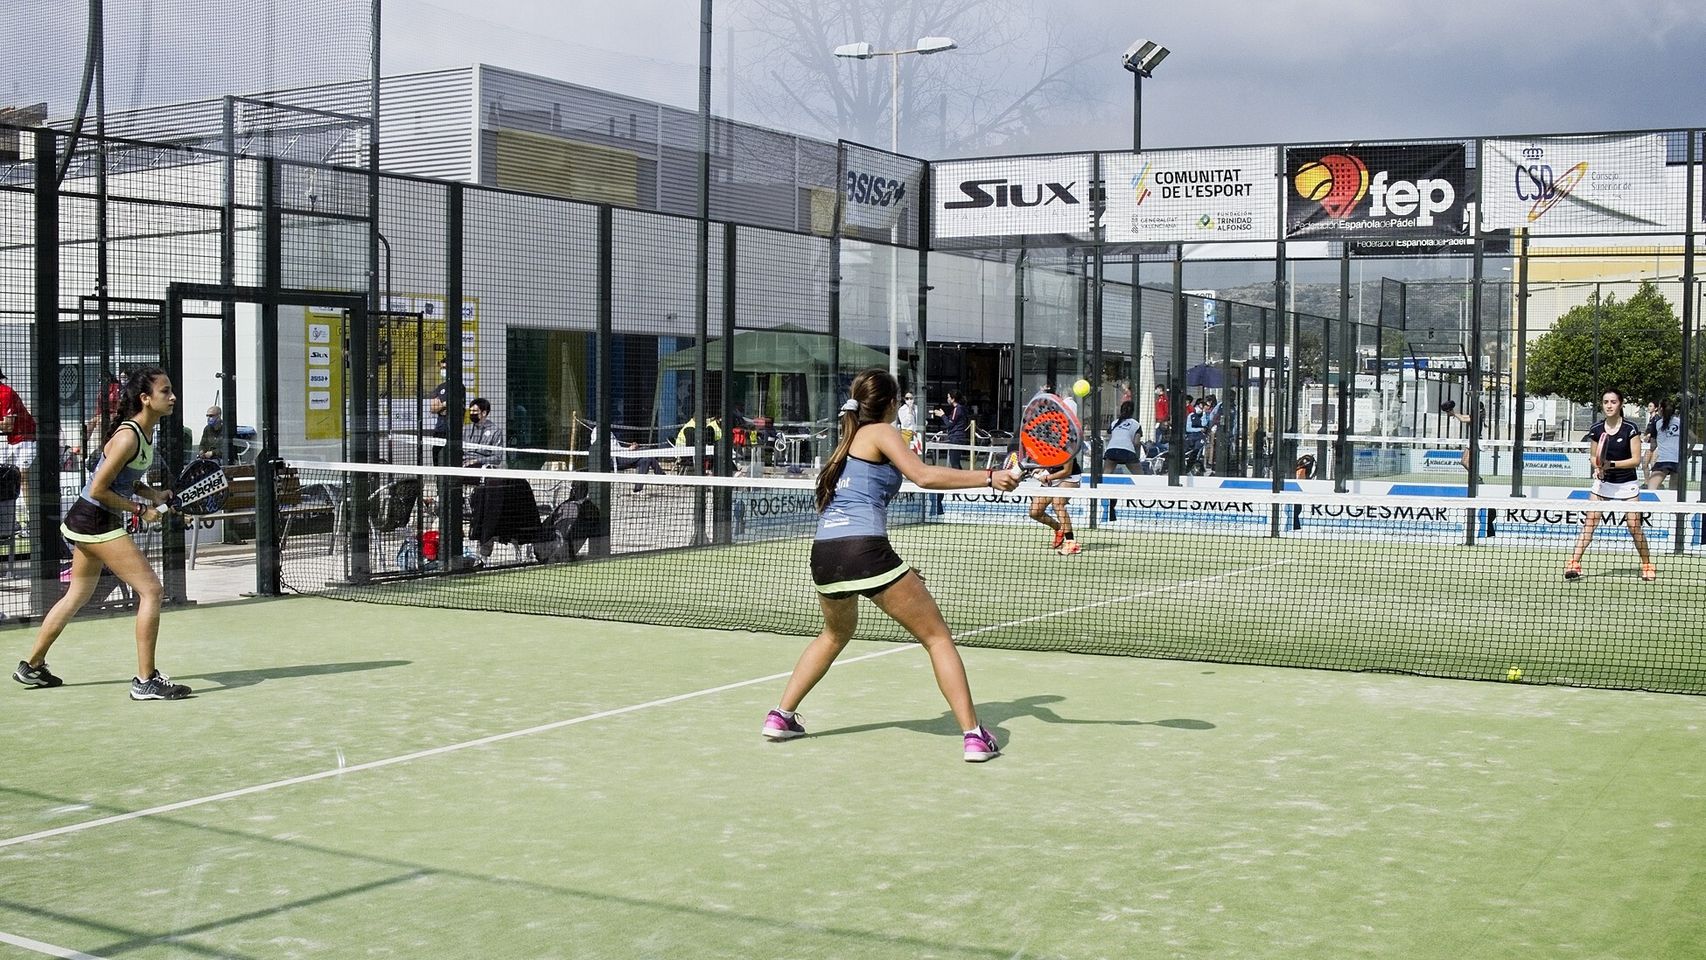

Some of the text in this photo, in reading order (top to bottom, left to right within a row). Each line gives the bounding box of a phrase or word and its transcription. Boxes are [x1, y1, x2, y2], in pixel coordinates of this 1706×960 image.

[1155, 169, 1241, 185] COMUNITAT
[1515, 164, 1555, 201] CSD
[1162, 183, 1253, 199] DE L'ESPORT
[1369, 171, 1455, 226] fep
[752, 496, 816, 516] ROGESMA
[1311, 503, 1448, 521] ROGESMAR
